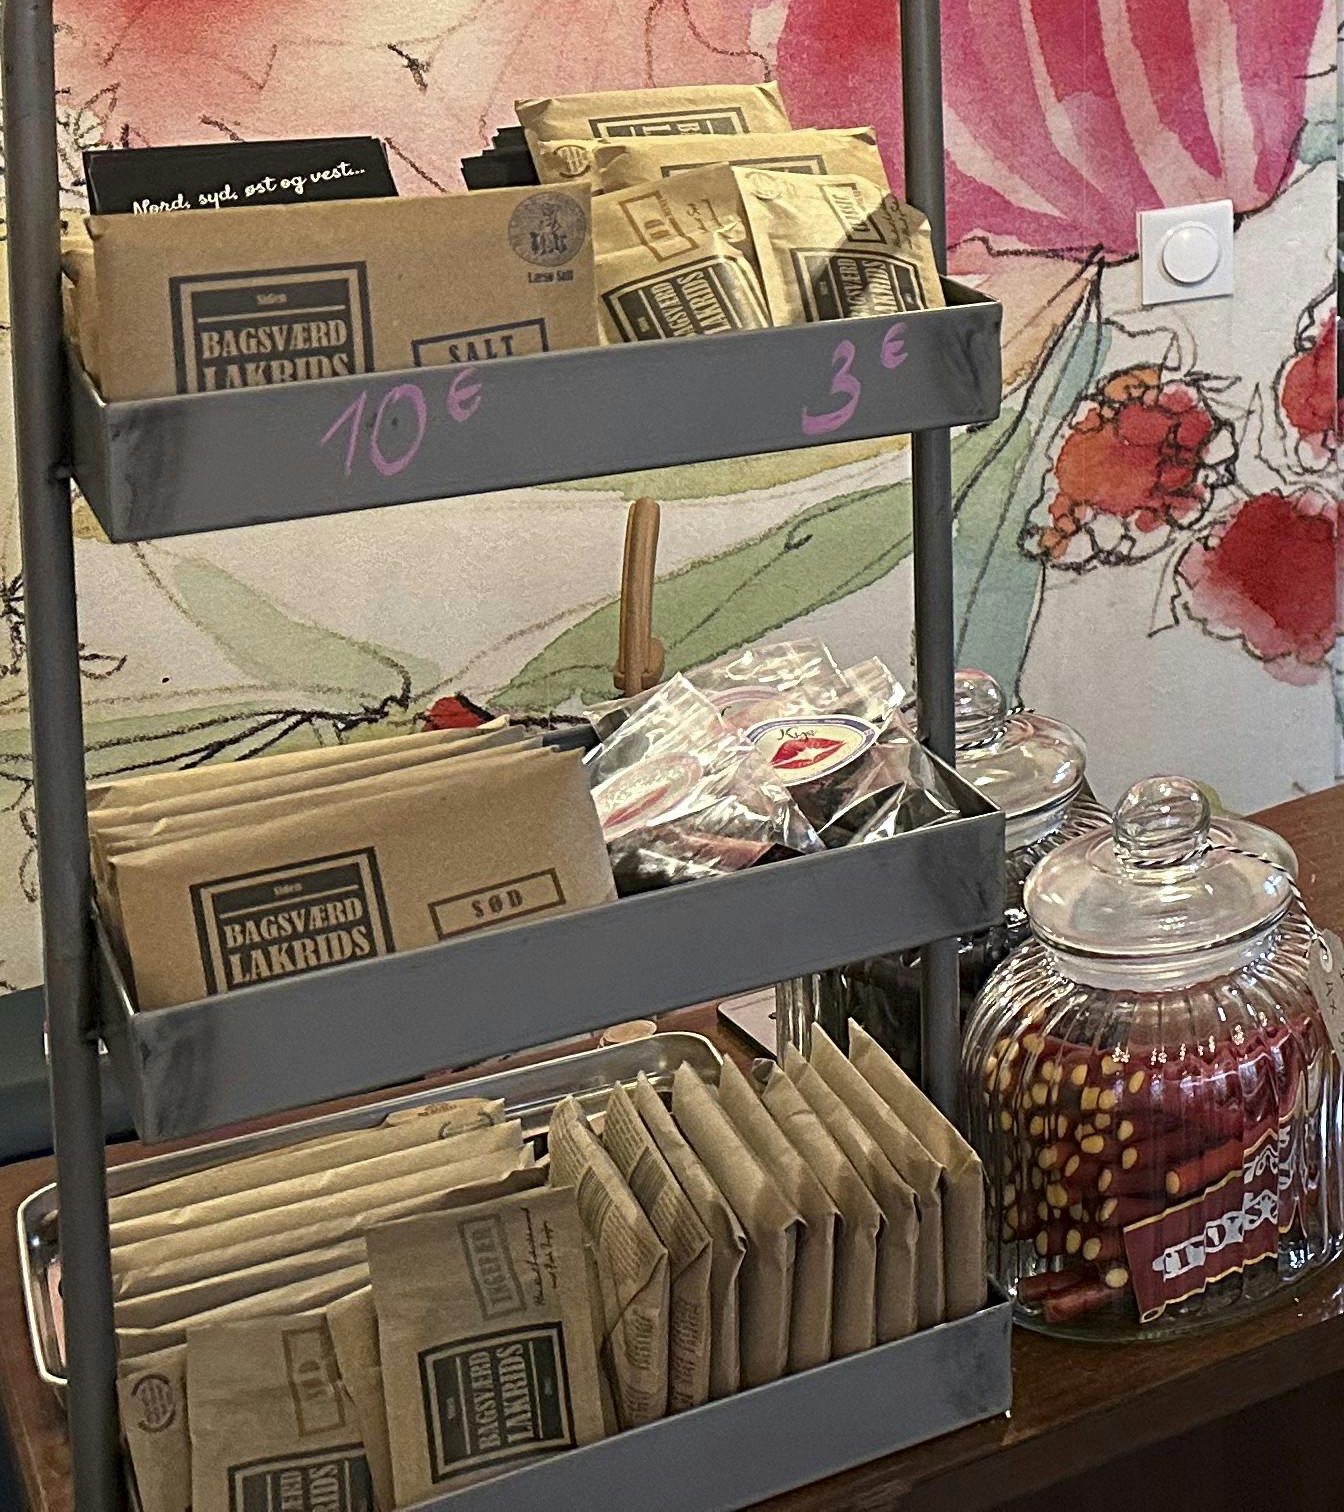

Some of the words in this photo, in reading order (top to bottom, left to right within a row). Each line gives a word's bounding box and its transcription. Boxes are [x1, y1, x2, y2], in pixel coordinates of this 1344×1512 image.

[279, 176, 308, 196] og
[651, 282, 699, 338] AGSVÆRD
[858, 259, 899, 313] AKRIDS
[200, 319, 348, 360] BAGSVÆRD
[448, 334, 514, 363] SALT
[223, 897, 364, 949] BAGSVÆRD
[471, 889, 523, 918] SØD
[229, 926, 371, 985] LAKRIDS
[468, 1350, 502, 1452] BAGSVÆRD
[496, 1342, 536, 1445] LAKRIDS
